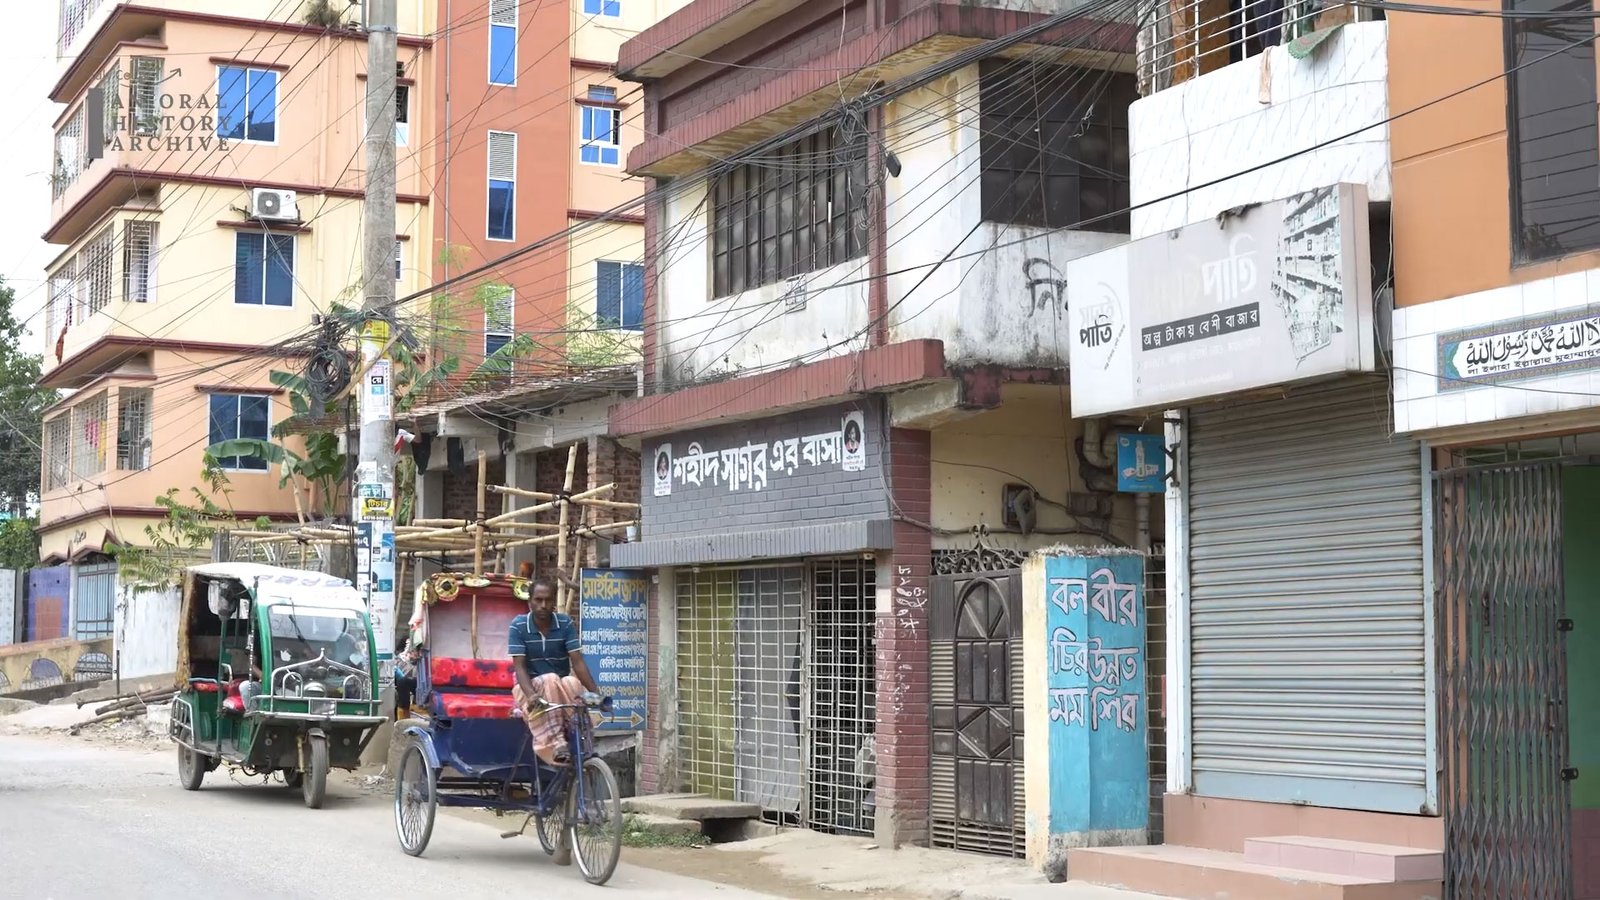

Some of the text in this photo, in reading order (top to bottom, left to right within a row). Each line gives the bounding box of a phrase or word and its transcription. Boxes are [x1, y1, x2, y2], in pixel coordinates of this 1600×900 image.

[1080, 314, 1112, 347] পাতি
[1143, 310, 1257, 346] অল্প টাকায় বেশী বাজার
[673, 431, 843, 491] শহীদ সাগর এর বাসা
[582, 571, 621, 600] আইরিন
[1049, 567, 1138, 628] বল বীর
[1050, 626, 1139, 686] চির উন্নত
[1049, 686, 1139, 732] মম শির
